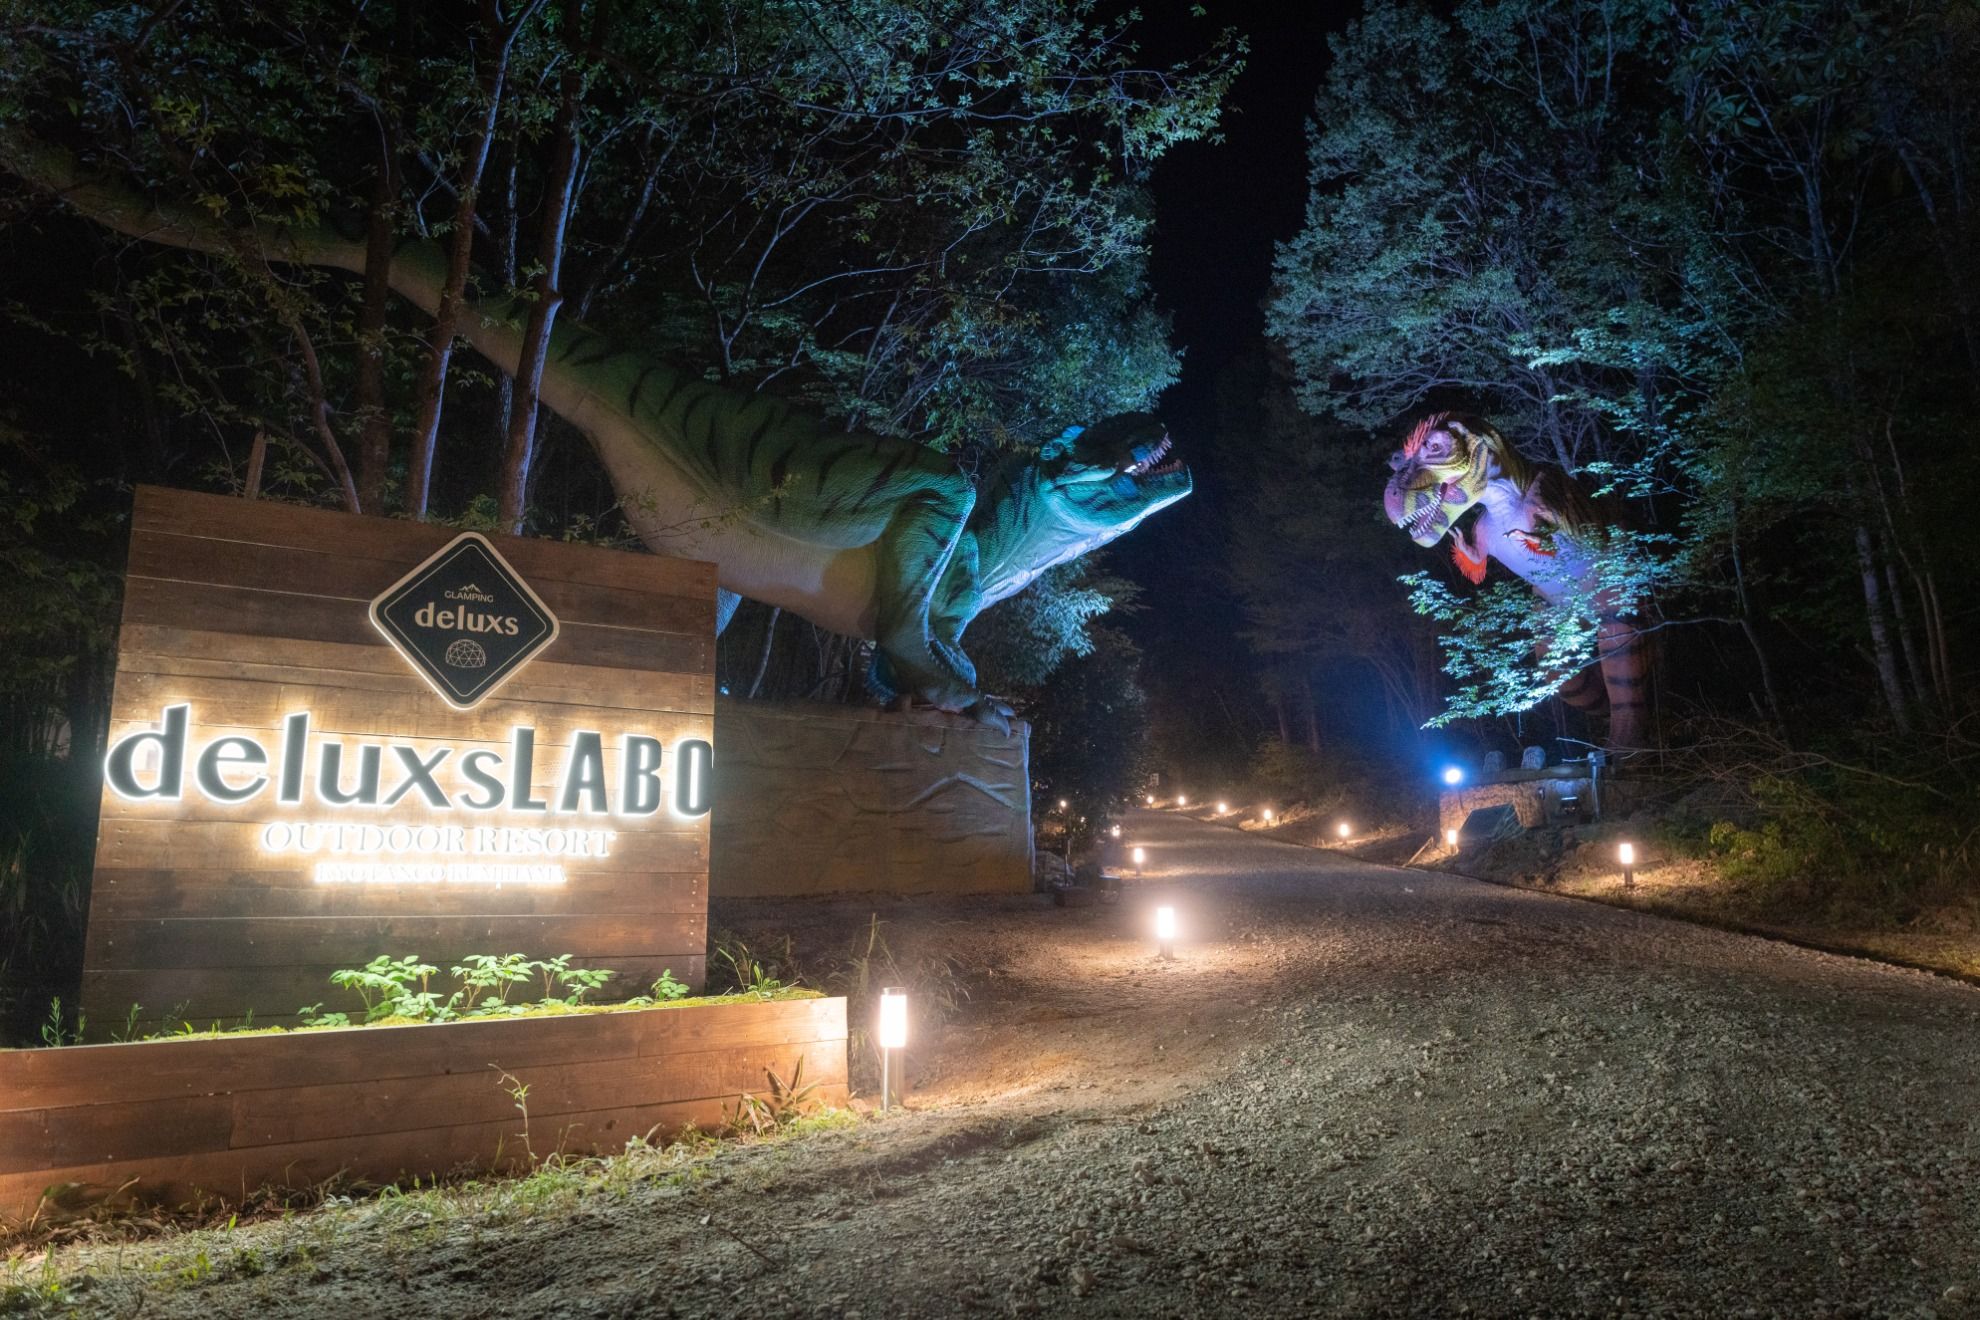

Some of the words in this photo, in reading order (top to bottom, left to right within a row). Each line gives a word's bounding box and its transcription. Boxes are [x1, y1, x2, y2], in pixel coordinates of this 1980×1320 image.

[444, 590, 493, 603] GLAMPING
[414, 602, 519, 635] deluxs
[105, 703, 713, 819] deluxsLABO
[265, 824, 466, 853] OUTDOOR
[478, 828, 616, 857] RESORT
